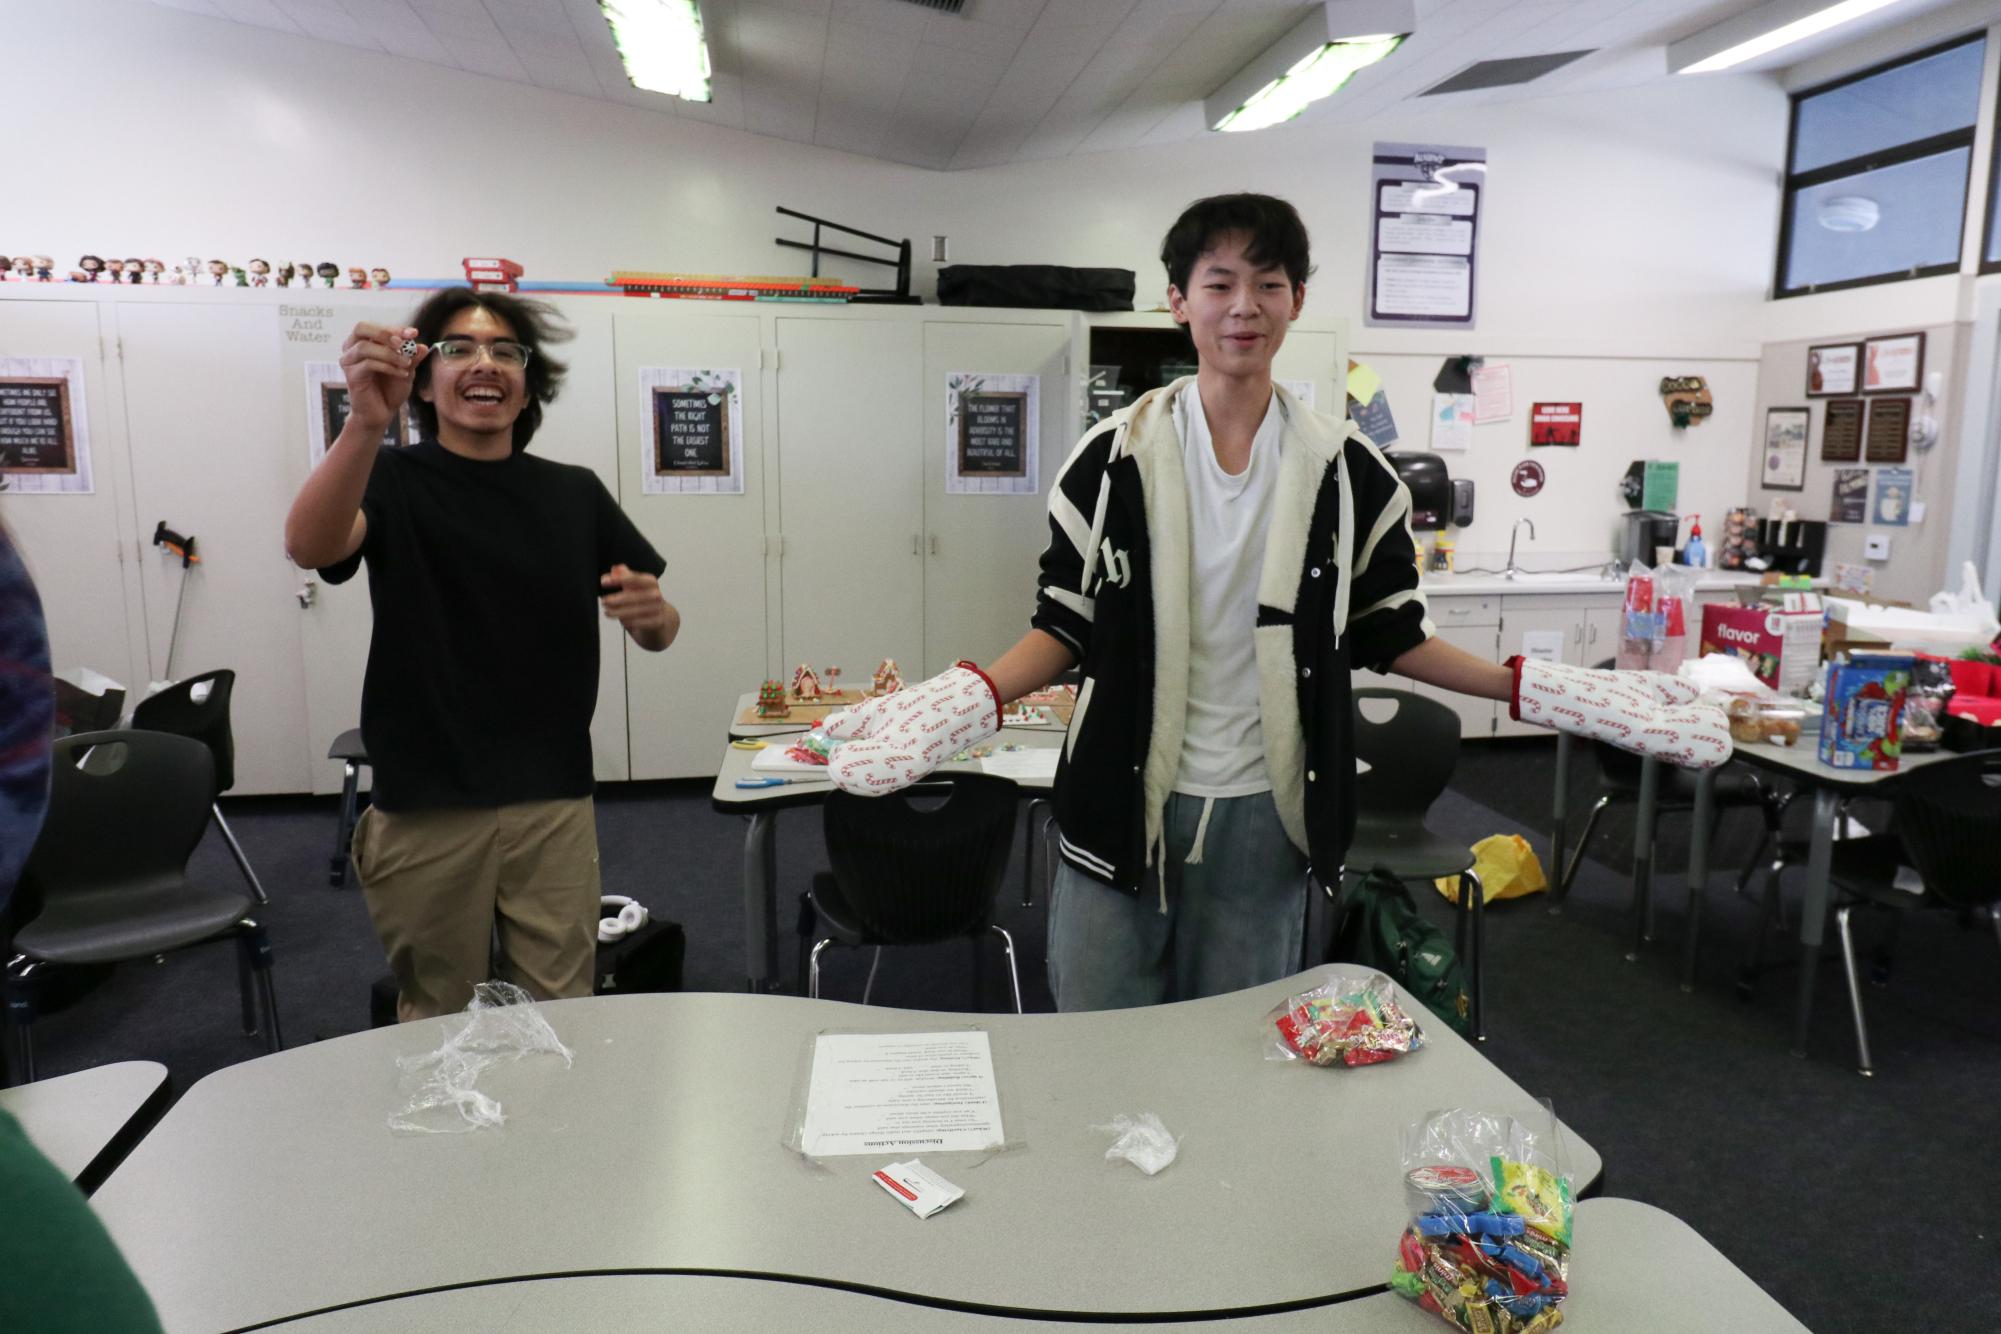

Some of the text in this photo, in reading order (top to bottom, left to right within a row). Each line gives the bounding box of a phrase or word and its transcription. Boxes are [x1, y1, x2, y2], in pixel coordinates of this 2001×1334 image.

[279, 304, 334, 318] Snacks
[292, 319, 323, 330] And
[285, 330, 332, 343] Water
[672, 399, 707, 409] SOMETIMES
[968, 404, 978, 413] THE
[979, 404, 1000, 413] FLOWER
[674, 411, 706, 421] THE RIGHT
[977, 415, 999, 424] BLOOMS
[670, 423, 710, 433] PATH IS NOT
[672, 435, 710, 446] THE EASIEST
[1716, 623, 1760, 645] flavor
[898, 1138, 944, 1146] Discussion
